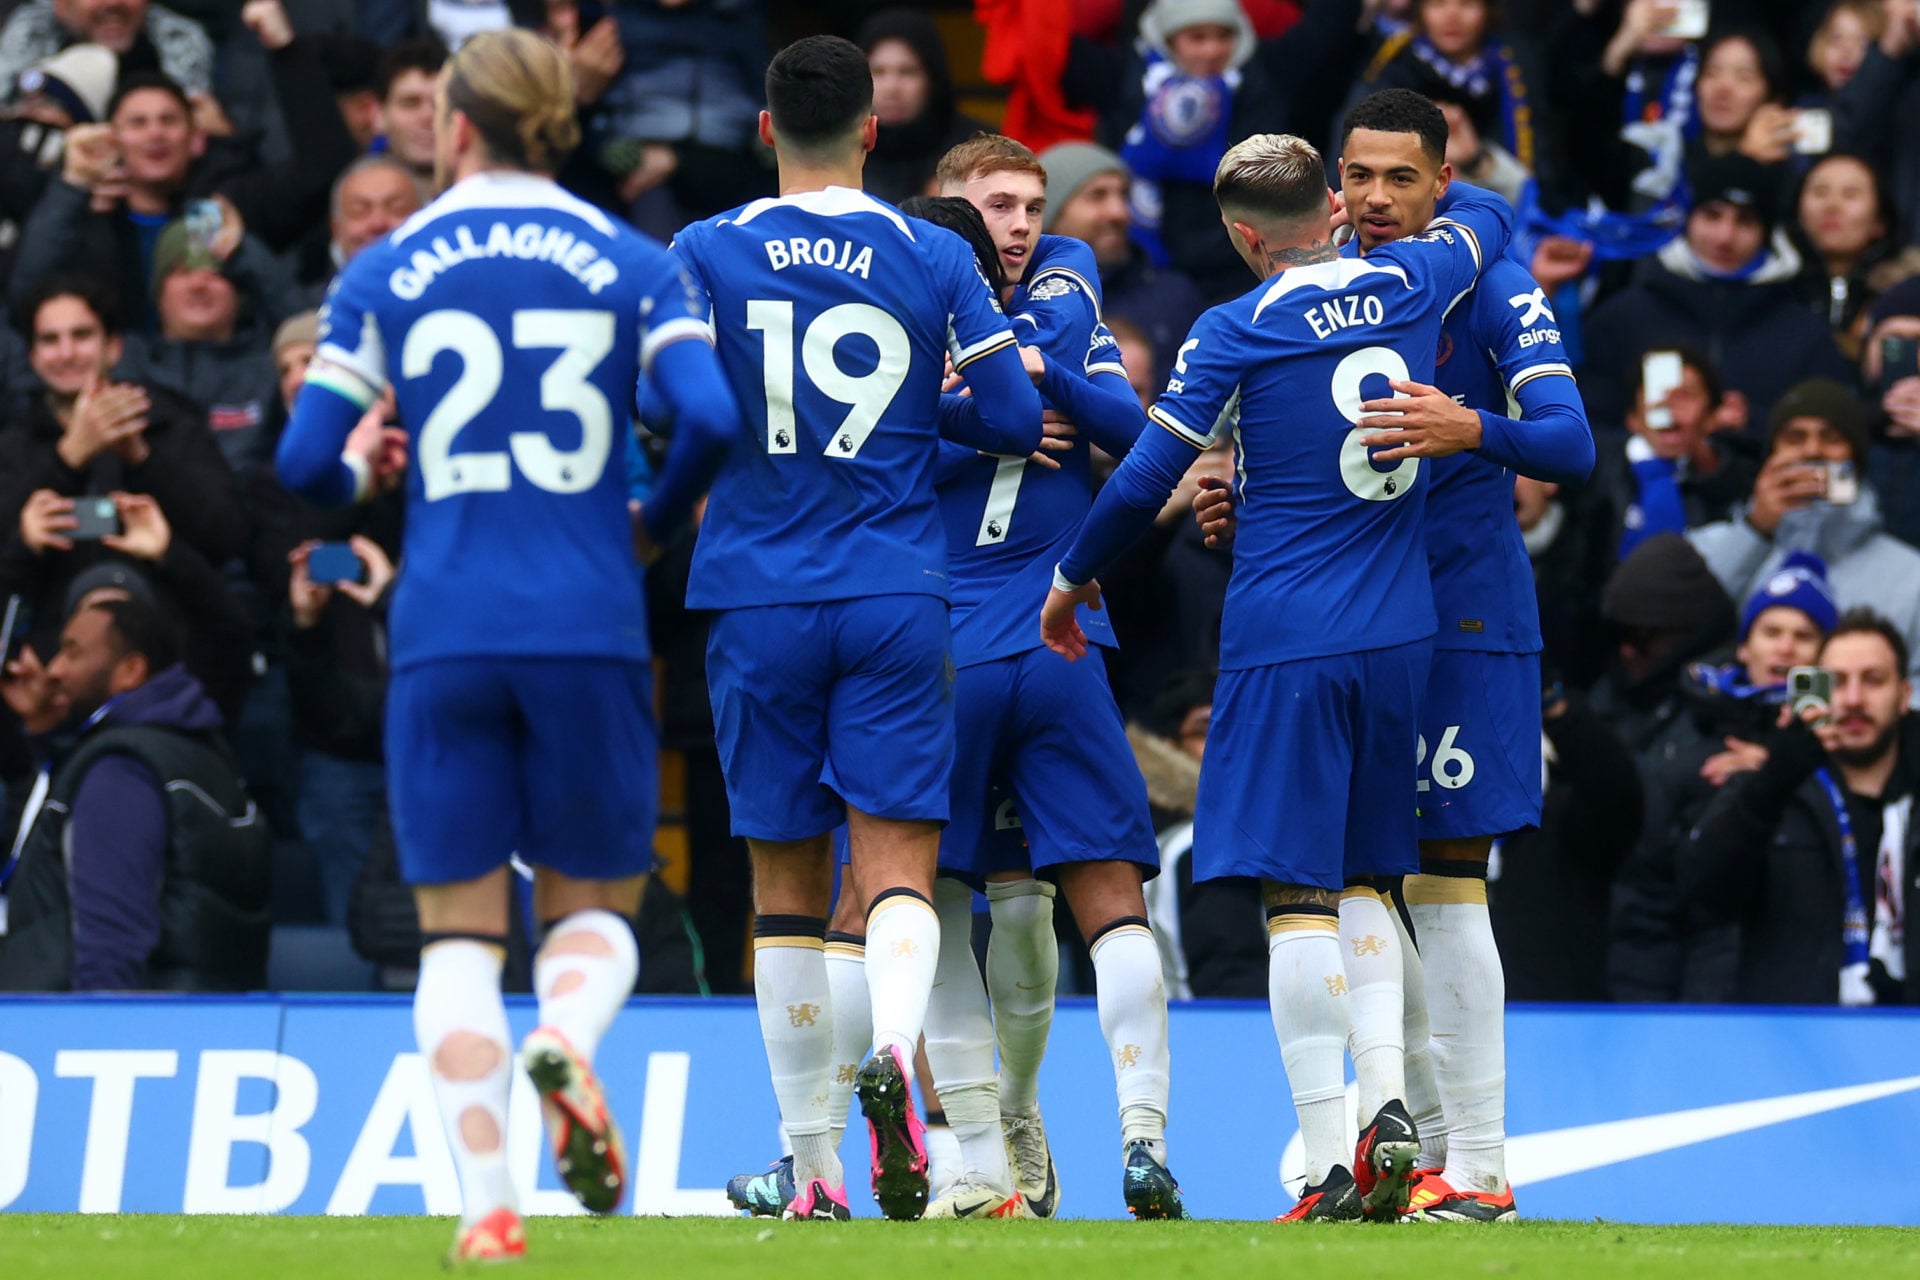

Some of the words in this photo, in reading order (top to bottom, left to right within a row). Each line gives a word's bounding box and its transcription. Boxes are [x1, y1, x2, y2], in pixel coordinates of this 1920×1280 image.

[389, 222, 618, 300] GALLAGHER
[764, 237, 873, 279] BROJA
[1304, 295, 1384, 340] ENZO
[402, 308, 616, 502] 23
[746, 300, 911, 459] 19
[1331, 346, 1420, 501] 8
